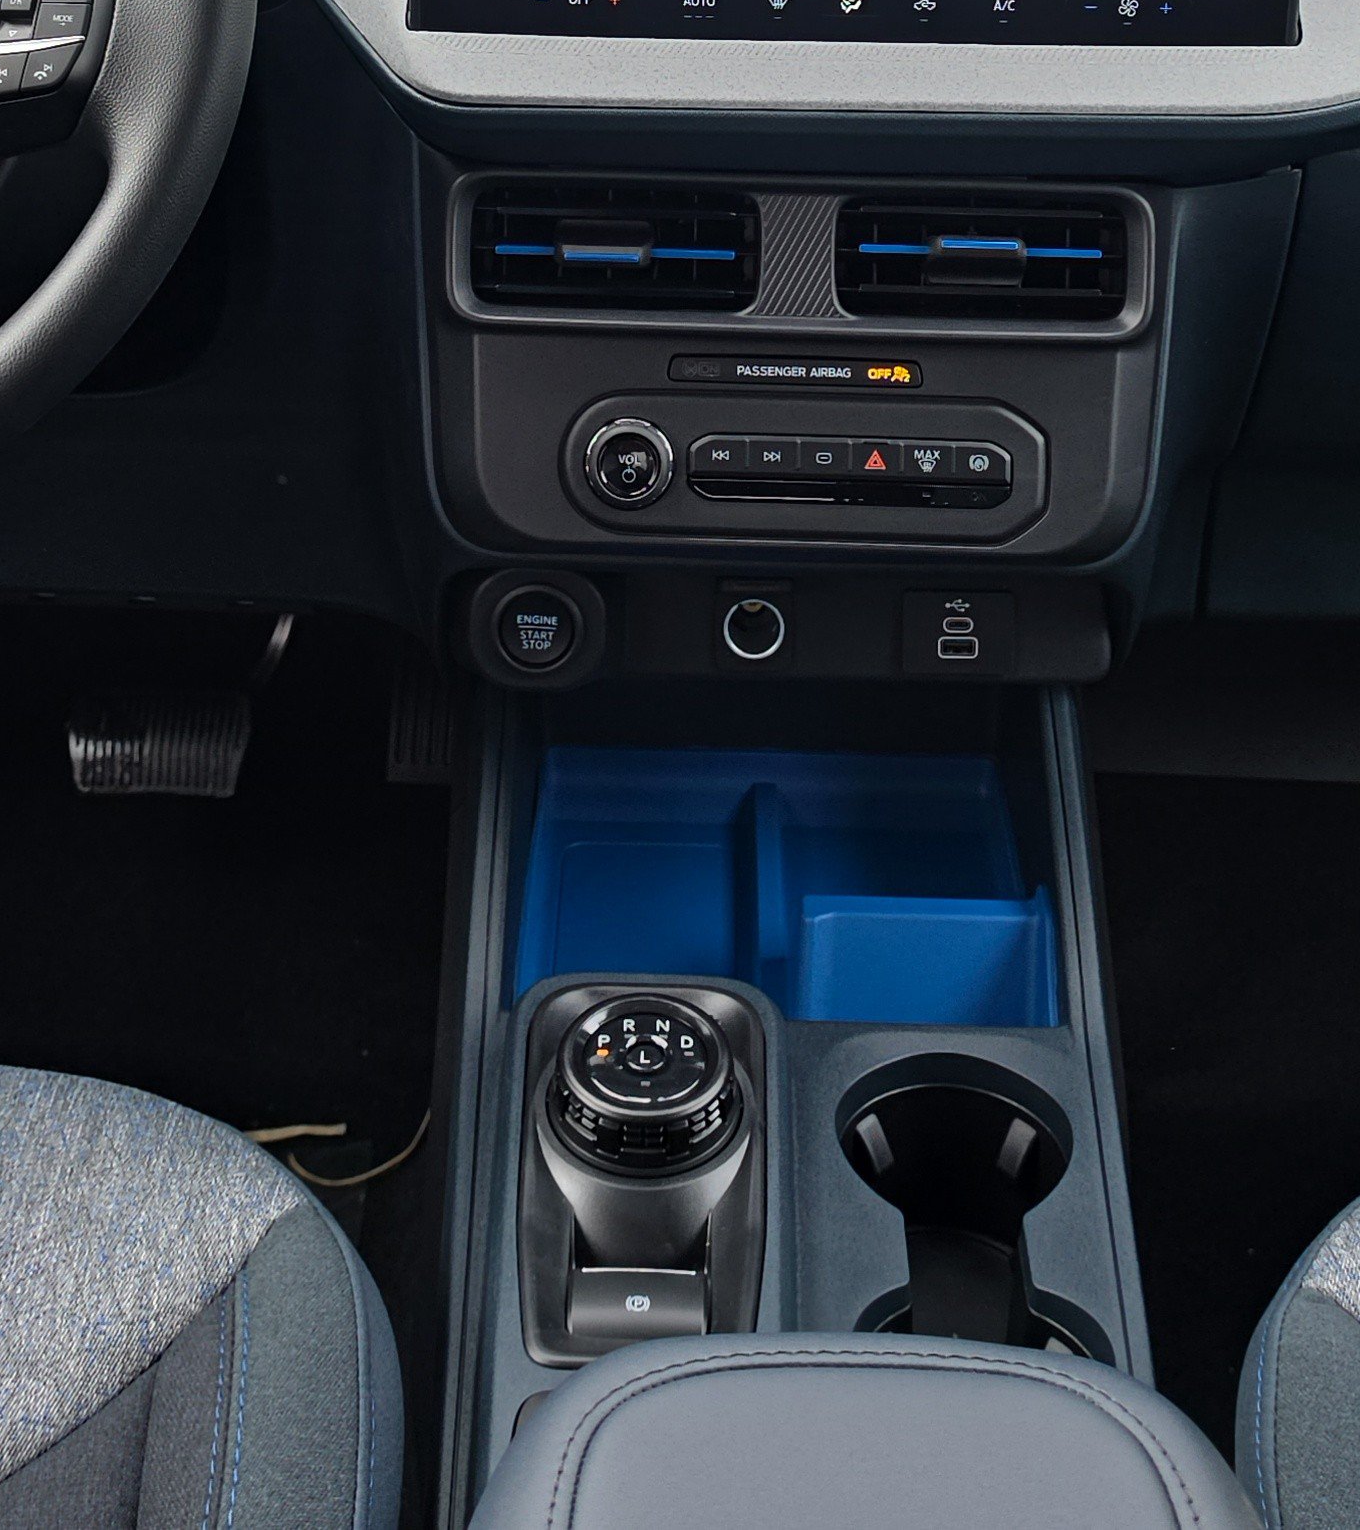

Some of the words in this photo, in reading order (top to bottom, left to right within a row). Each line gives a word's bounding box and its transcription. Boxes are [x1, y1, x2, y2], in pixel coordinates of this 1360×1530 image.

[53, 14, 73, 23] MODE
[736, 365, 807, 378] PASSENGER
[810, 366, 852, 379] AIRBAG
[867, 368, 891, 380] OFF
[617, 453, 641, 466] VOL
[913, 449, 941, 461] MAX
[516, 614, 558, 627] ENGINE
[519, 630, 554, 641] START
[522, 639, 551, 651] STOP
[597, 1035, 610, 1049] P
[623, 1018, 636, 1032] R
[655, 1019, 670, 1033] N
[680, 1035, 694, 1049] D
[639, 1051, 651, 1064] L
